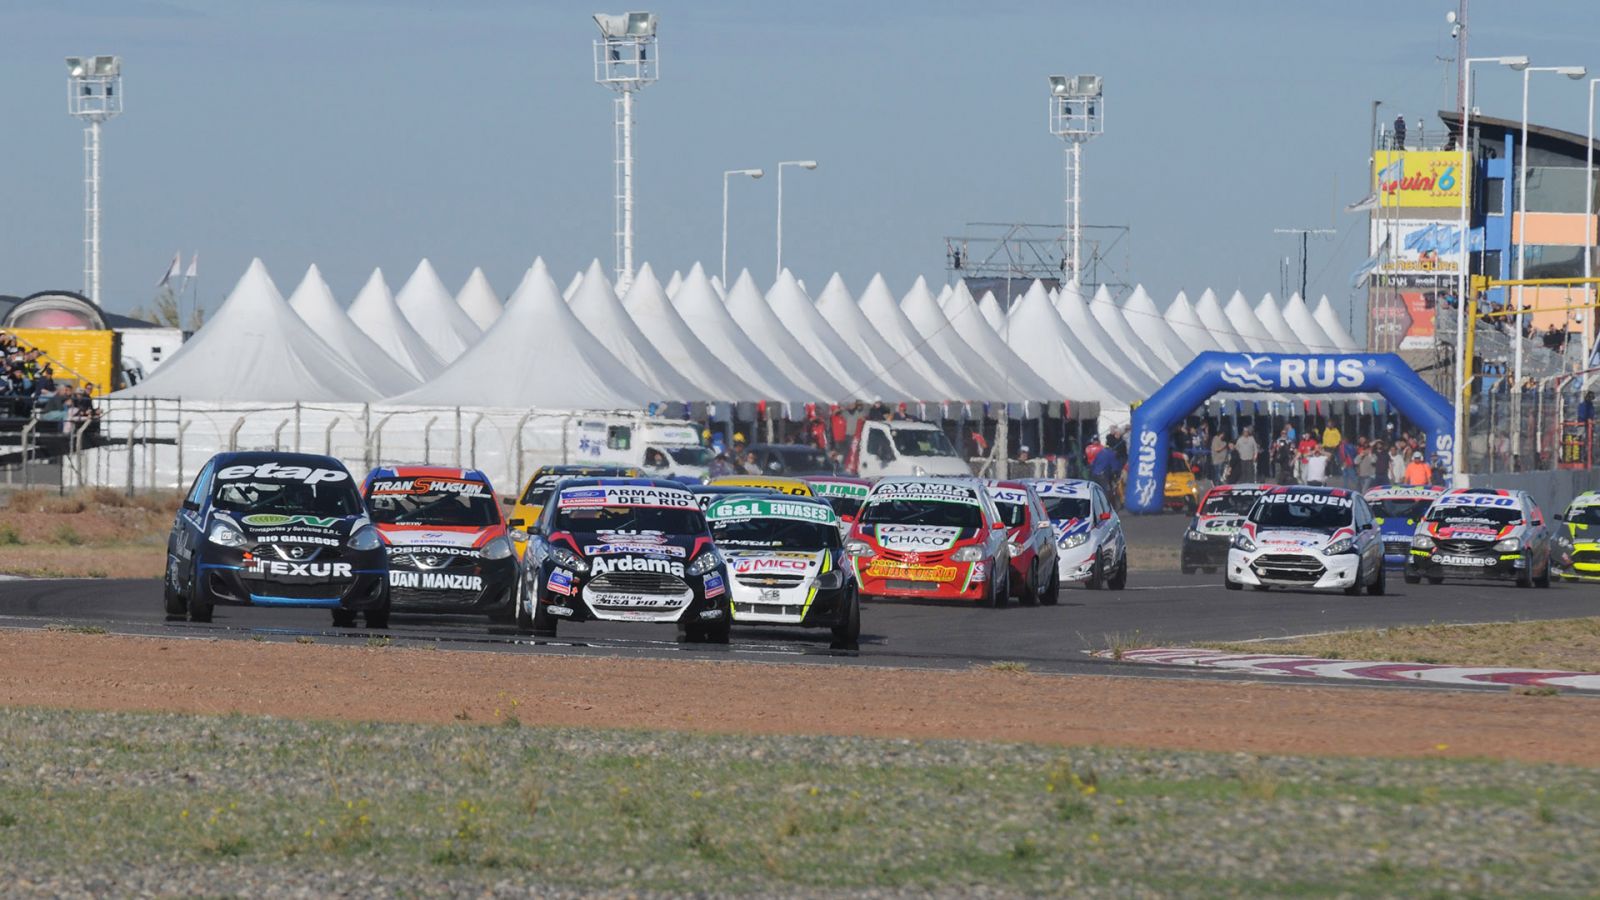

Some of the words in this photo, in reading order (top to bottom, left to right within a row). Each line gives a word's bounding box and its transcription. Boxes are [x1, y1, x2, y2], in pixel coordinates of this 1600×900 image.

[1438, 167, 1454, 191] 6
[1279, 358, 1365, 388] RUS
[1138, 431, 1157, 477] RUS
[217, 462, 348, 484] etap
[607, 489, 695, 501] ARMANDO
[830, 485, 868, 497] ITALO
[878, 482, 969, 494] AYAMIX
[618, 496, 651, 505] DEL
[659, 498, 689, 507] RIO
[1260, 493, 1352, 509] NEUQUEN
[1440, 496, 1514, 506] ESCO
[716, 502, 763, 517] G&L
[770, 503, 828, 521] ENVASES
[280, 535, 340, 547] GALLEGOS
[889, 535, 945, 546] CHACO
[590, 555, 685, 578] Ardama
[753, 559, 806, 571] MICO
[389, 571, 419, 588] UAN
[422, 573, 482, 591] MANZUR
